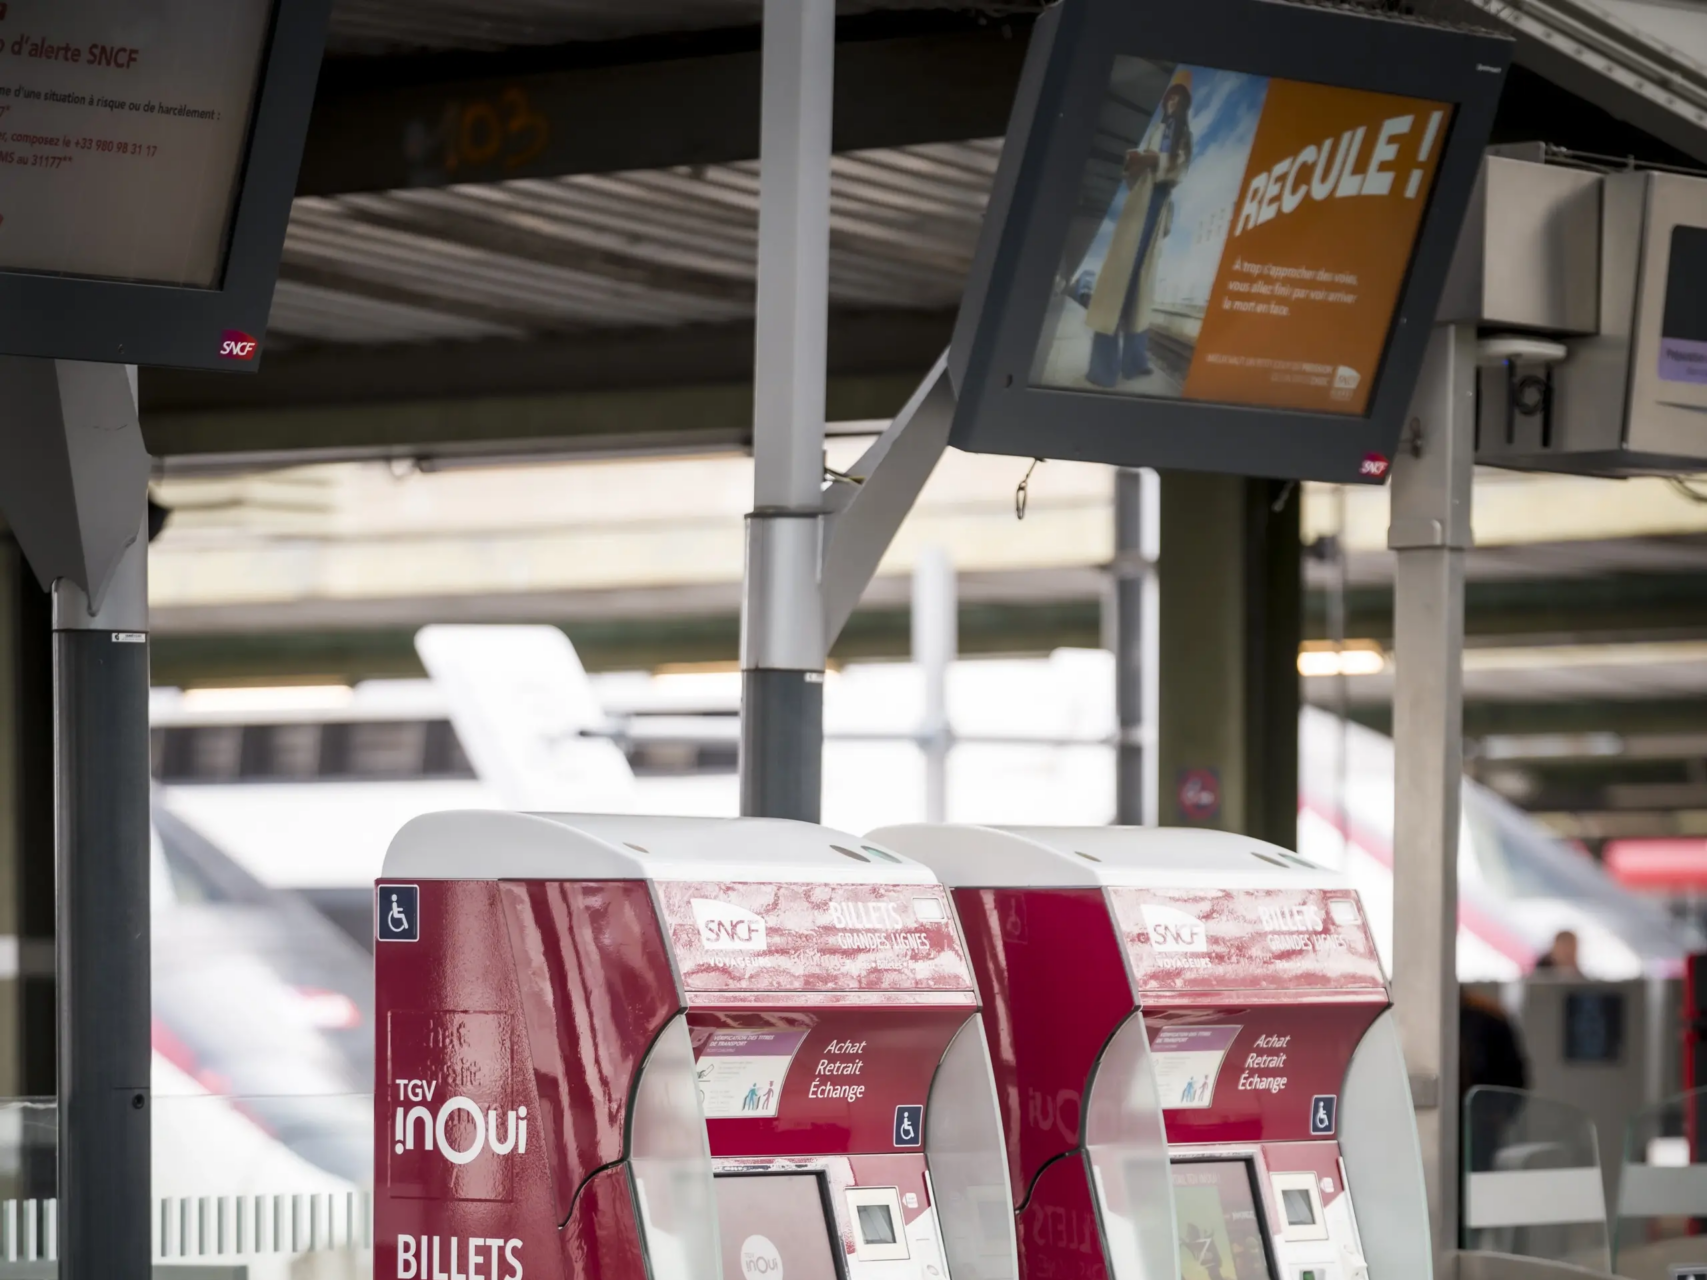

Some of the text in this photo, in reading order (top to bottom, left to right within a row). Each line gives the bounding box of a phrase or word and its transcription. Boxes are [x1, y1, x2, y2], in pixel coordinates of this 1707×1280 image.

[11, 33, 81, 63] d'alerte
[86, 43, 139, 69] SNCF
[14, 85, 41, 100] d'une
[44, 89, 86, 105] situation
[88, 94, 94, 106] à
[96, 96, 126, 114] risque
[129, 101, 141, 111] ou
[143, 100, 156, 113] de
[158, 101, 215, 120] harcèlement
[11, 132, 60, 147] composez
[62, 135, 71, 148] le
[74, 138, 93, 150] +33
[95, 140, 114, 153] 980
[116, 141, 129, 154] 98
[130, 144, 142, 157] 31
[146, 145, 158, 158] 17
[16, 156, 29, 166] au
[1234, 114, 1415, 237] RECULE
[1228, 281, 1250, 292] vous
[220, 340, 256, 356] SNCF
[1359, 459, 1388, 475] SNCF
[829, 902, 902, 928] BILLETS
[1258, 905, 1323, 931] BILLETS
[704, 918, 761, 943] SNCF
[838, 933, 930, 949] GRANDES LIGNES
[1153, 923, 1200, 946] SNCF
[1267, 934, 1312, 950] GRANDES
[824, 1040, 867, 1054] Achat
[1253, 1033, 1291, 1048] Achat
[815, 1059, 862, 1075] Retrait
[1245, 1053, 1286, 1068] Retrait
[396, 1079, 437, 1102] TGV
[808, 1079, 865, 1102] Échange
[1238, 1070, 1287, 1093] Échange
